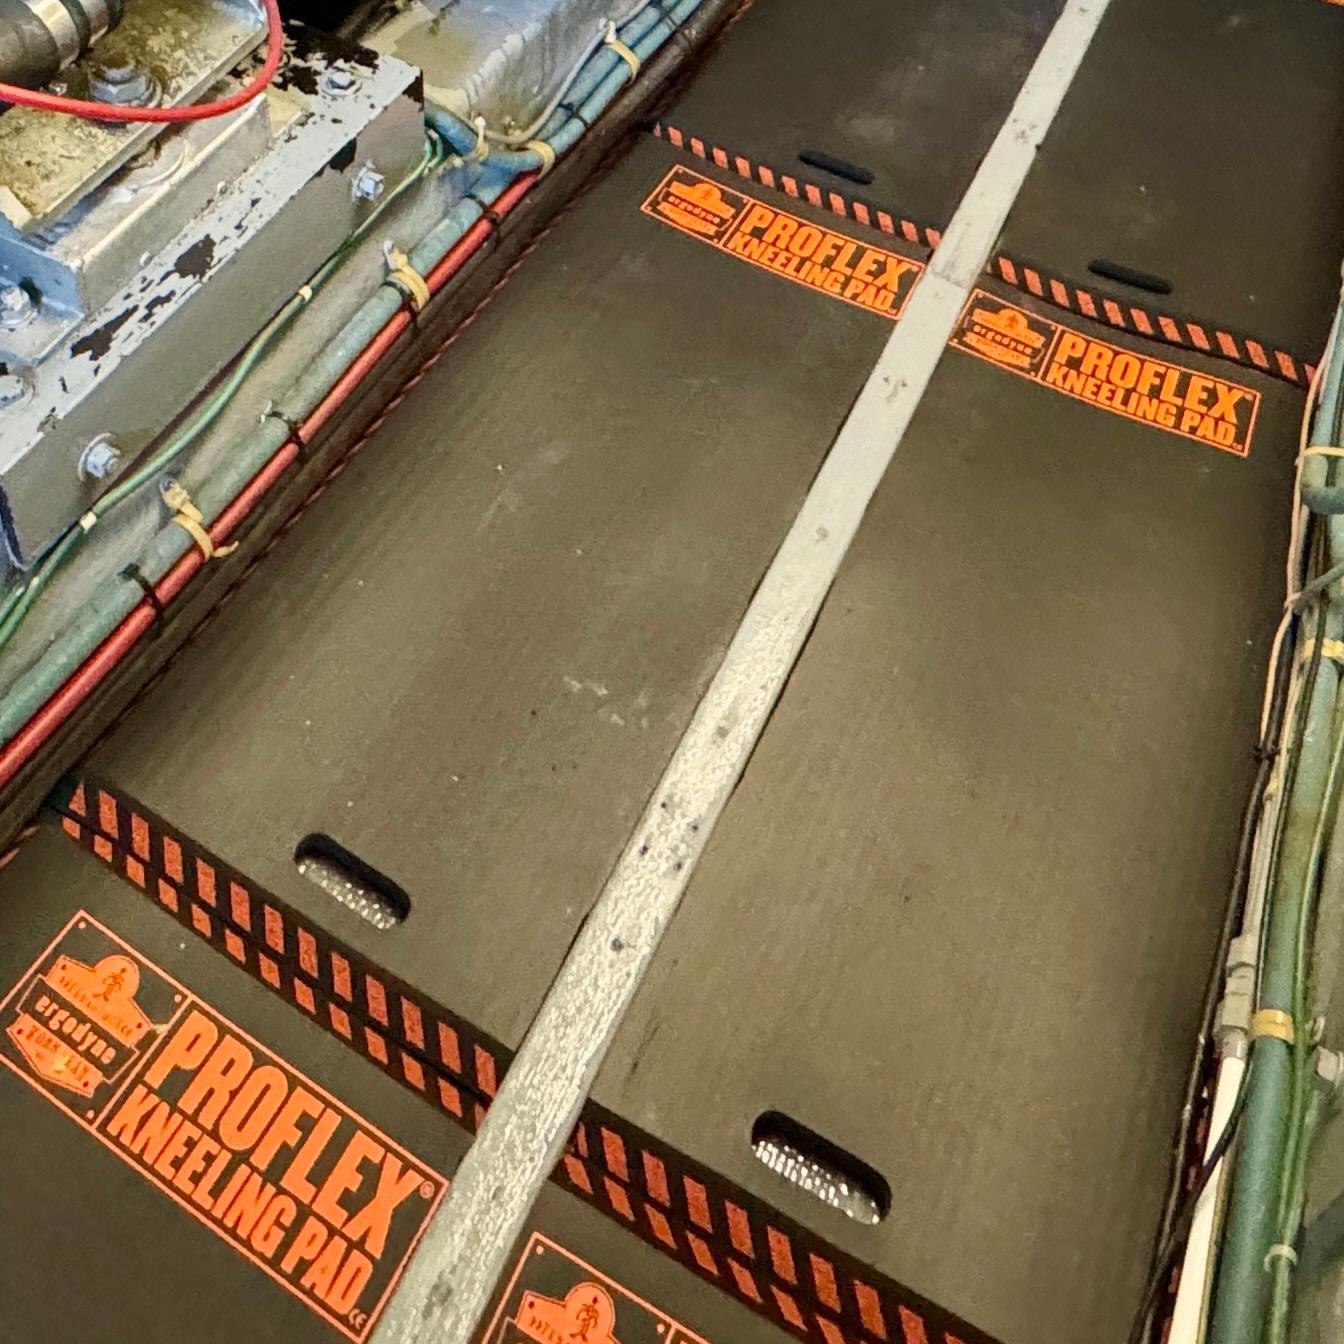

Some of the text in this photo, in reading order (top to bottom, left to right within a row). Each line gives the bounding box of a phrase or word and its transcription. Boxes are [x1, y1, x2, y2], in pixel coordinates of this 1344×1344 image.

[727, 231, 897, 311] KNEELING PAD
[738, 205, 910, 293] PROFLEX
[1046, 361, 1237, 447] KNEELING PAD
[1053, 332, 1245, 425] PROFLEX
[34, 993, 117, 1065] ergodyne
[142, 1010, 425, 1260] PROFLEX
[106, 1083, 374, 1315] KNEELING PAD
